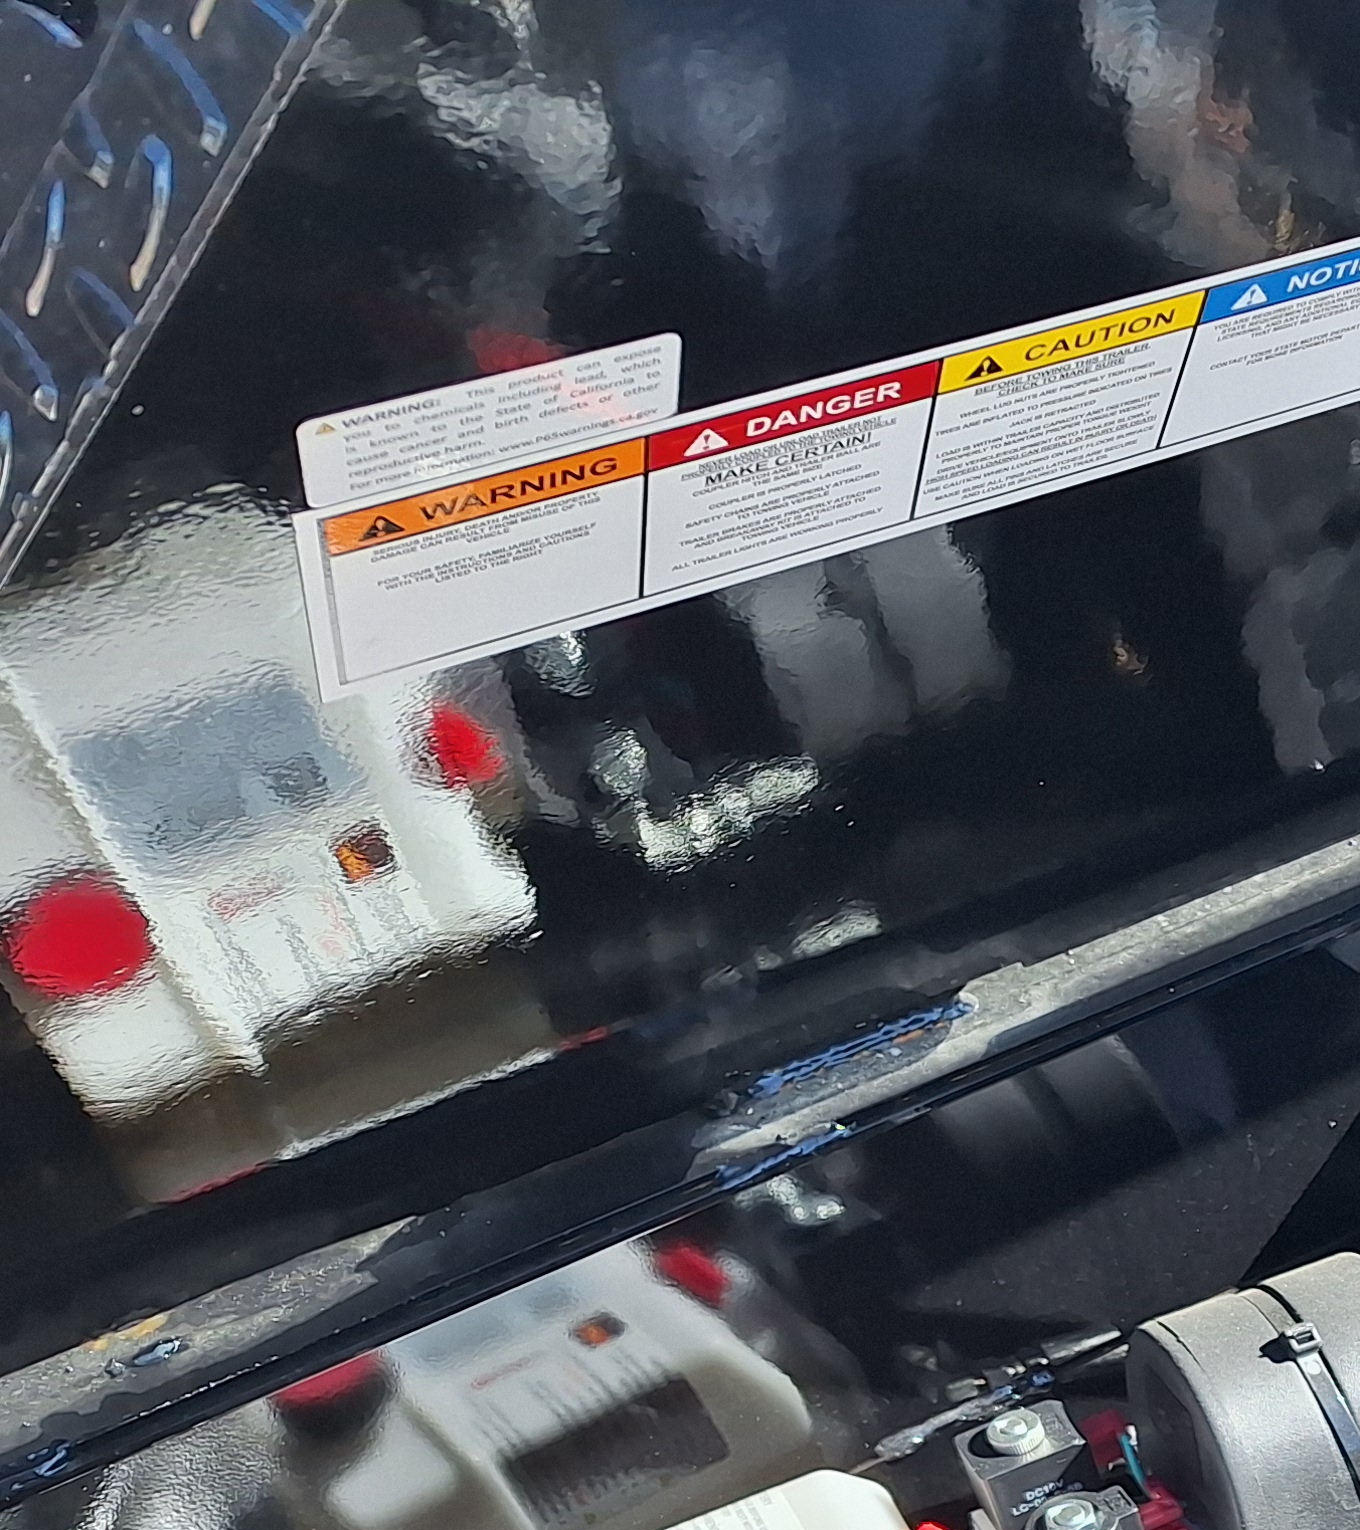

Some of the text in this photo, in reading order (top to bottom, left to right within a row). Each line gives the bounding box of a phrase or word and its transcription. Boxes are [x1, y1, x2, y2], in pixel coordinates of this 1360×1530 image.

[1022, 307, 1177, 363] CAUTION
[1208, 354, 1248, 371] CONTACT
[1248, 347, 1273, 360] YOUR
[1272, 340, 1299, 353] STATE
[1298, 331, 1329, 345] MOTOR
[1245, 333, 1343, 366] FOR MORE INFORMATION
[341, 344, 661, 429] WARNING: This product can expose
[342, 428, 371, 443] you
[384, 420, 400, 432] to
[413, 399, 485, 425] chemicals
[497, 381, 561, 405] including
[620, 356, 660, 374] which
[958, 360, 1156, 420] WHEEL LUG NUTS ARE PROPERLY TIGHTENED
[974, 375, 1025, 396] BEFORE
[1025, 363, 1071, 382] TOWING
[1074, 355, 1099, 369] THIS
[996, 356, 1126, 398] CHECK TO MAKE SURE
[345, 369, 661, 454] is known to the State of California to
[345, 381, 659, 466] cause cancer and birth defects or other
[744, 378, 904, 439] DANGER
[347, 437, 485, 479] reproductive harm.
[349, 478, 372, 491] For
[374, 469, 411, 484] more
[497, 406, 658, 453] www.P65warnings.ca.gov
[704, 431, 872, 485] MAKE CERTAIN!
[751, 463, 823, 487] THE SAME SIZE
[418, 454, 618, 523] WARNING
[708, 463, 862, 511] COUPLER IS PROPERLY LATCHED
[370, 496, 600, 563] DAMAGE CAN RESULT FROM MISUSE OF THIS
[372, 537, 420, 556] SERIOUS
[464, 516, 499, 532] DEATH
[501, 505, 541, 522] AND/OR
[543, 490, 598, 511] PROPERTY
[465, 526, 510, 544] VEHICLE
[671, 506, 882, 572] ALL TRAILER LIGHTS ARE WORKING PROPERLY
[377, 574, 400, 586] FOR
[402, 566, 431, 580] YOUR
[477, 536, 541, 559] FAMILIARIZE
[542, 521, 596, 542] YOURSELF
[384, 529, 589, 591] WITH THE INSTRUCTIONS AND CAUTIONS
[434, 548, 543, 583] LISTED TO THE RIGHT
